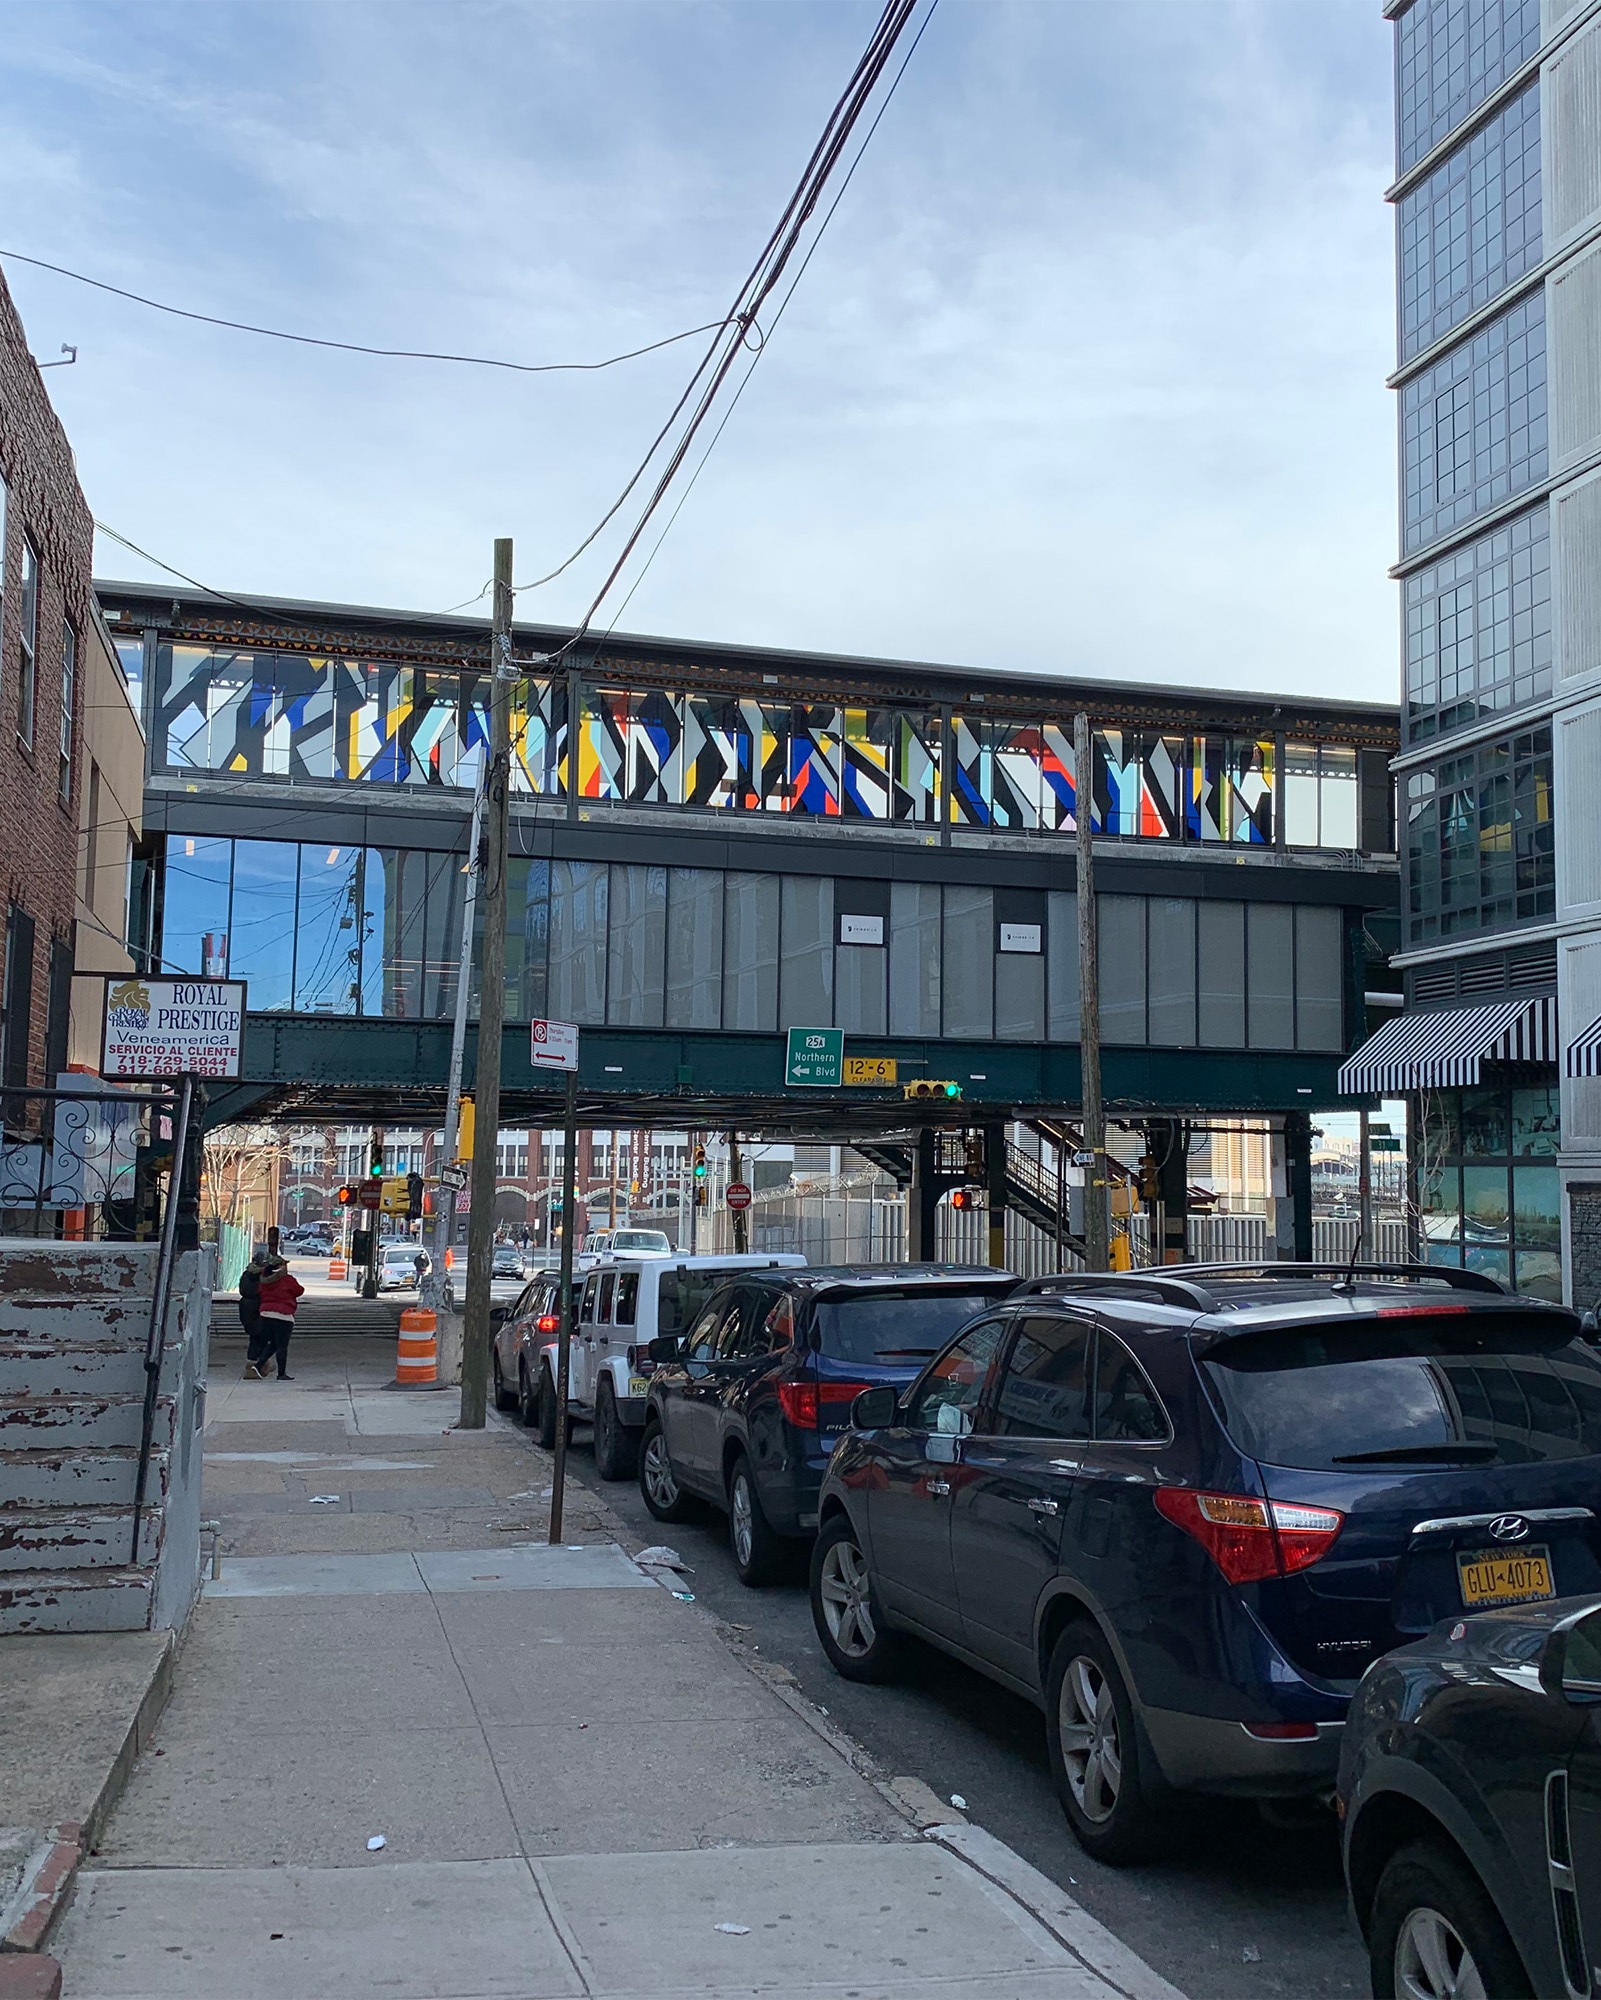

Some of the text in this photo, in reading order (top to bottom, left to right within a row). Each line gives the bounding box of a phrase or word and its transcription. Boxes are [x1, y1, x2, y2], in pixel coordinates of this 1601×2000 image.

[172, 984, 228, 1006] ROYAL
[157, 1009, 240, 1031] PRESTIGE
[117, 1030, 230, 1046] Veneamerica
[807, 1037, 824, 1047] 25A
[109, 1045, 238, 1057] SERVICIO AL CLIENTE
[117, 1055, 228, 1066] 718-729-5044
[795, 1052, 835, 1062] Northern
[117, 1065, 227, 1076] 917-6045801
[816, 1067, 835, 1077] Blvd
[632, 1382, 647, 1393] K62
[1479, 1552, 1502, 1562] NEW
[1503, 1549, 1526, 1560] YORK
[1467, 1561, 1544, 1593] GLU 4073
